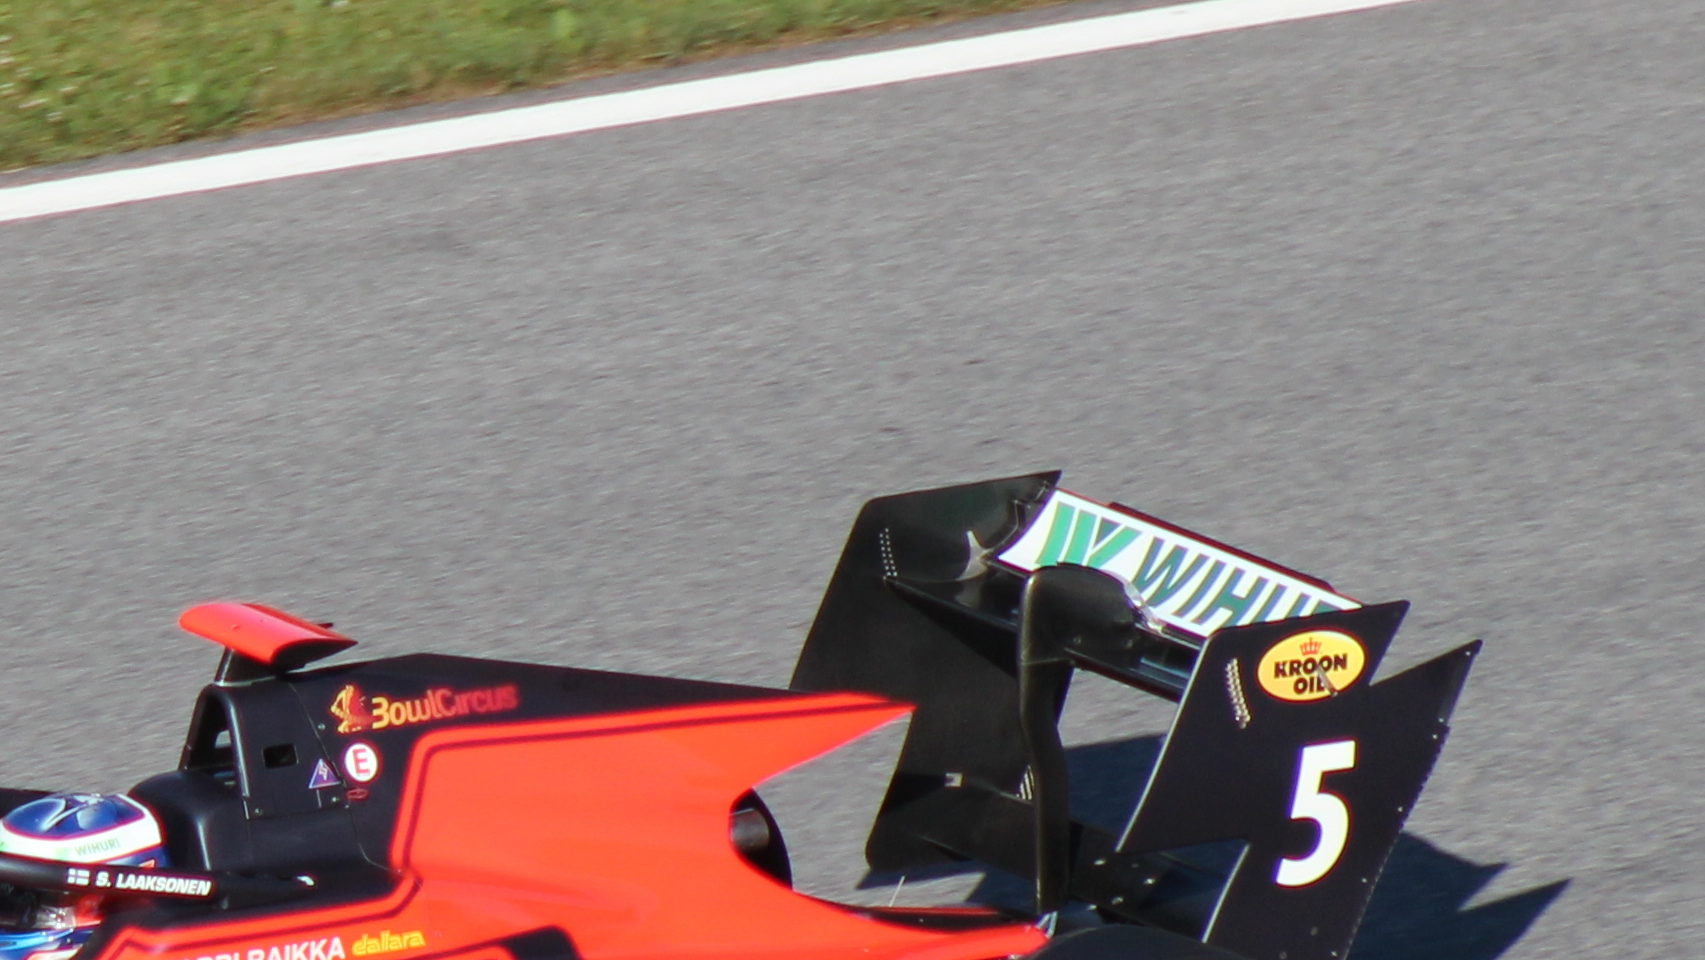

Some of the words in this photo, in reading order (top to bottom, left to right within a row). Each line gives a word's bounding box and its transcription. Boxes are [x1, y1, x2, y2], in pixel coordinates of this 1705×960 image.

[1274, 653, 1348, 679] KROON
[1293, 677, 1325, 695] OIL
[352, 748, 371, 774] E
[1276, 740, 1356, 886] 5
[75, 837, 121, 857] WIHURI
[96, 871, 112, 888] S.
[116, 873, 212, 897] LAAKSONEN
[352, 930, 426, 957] dallara
